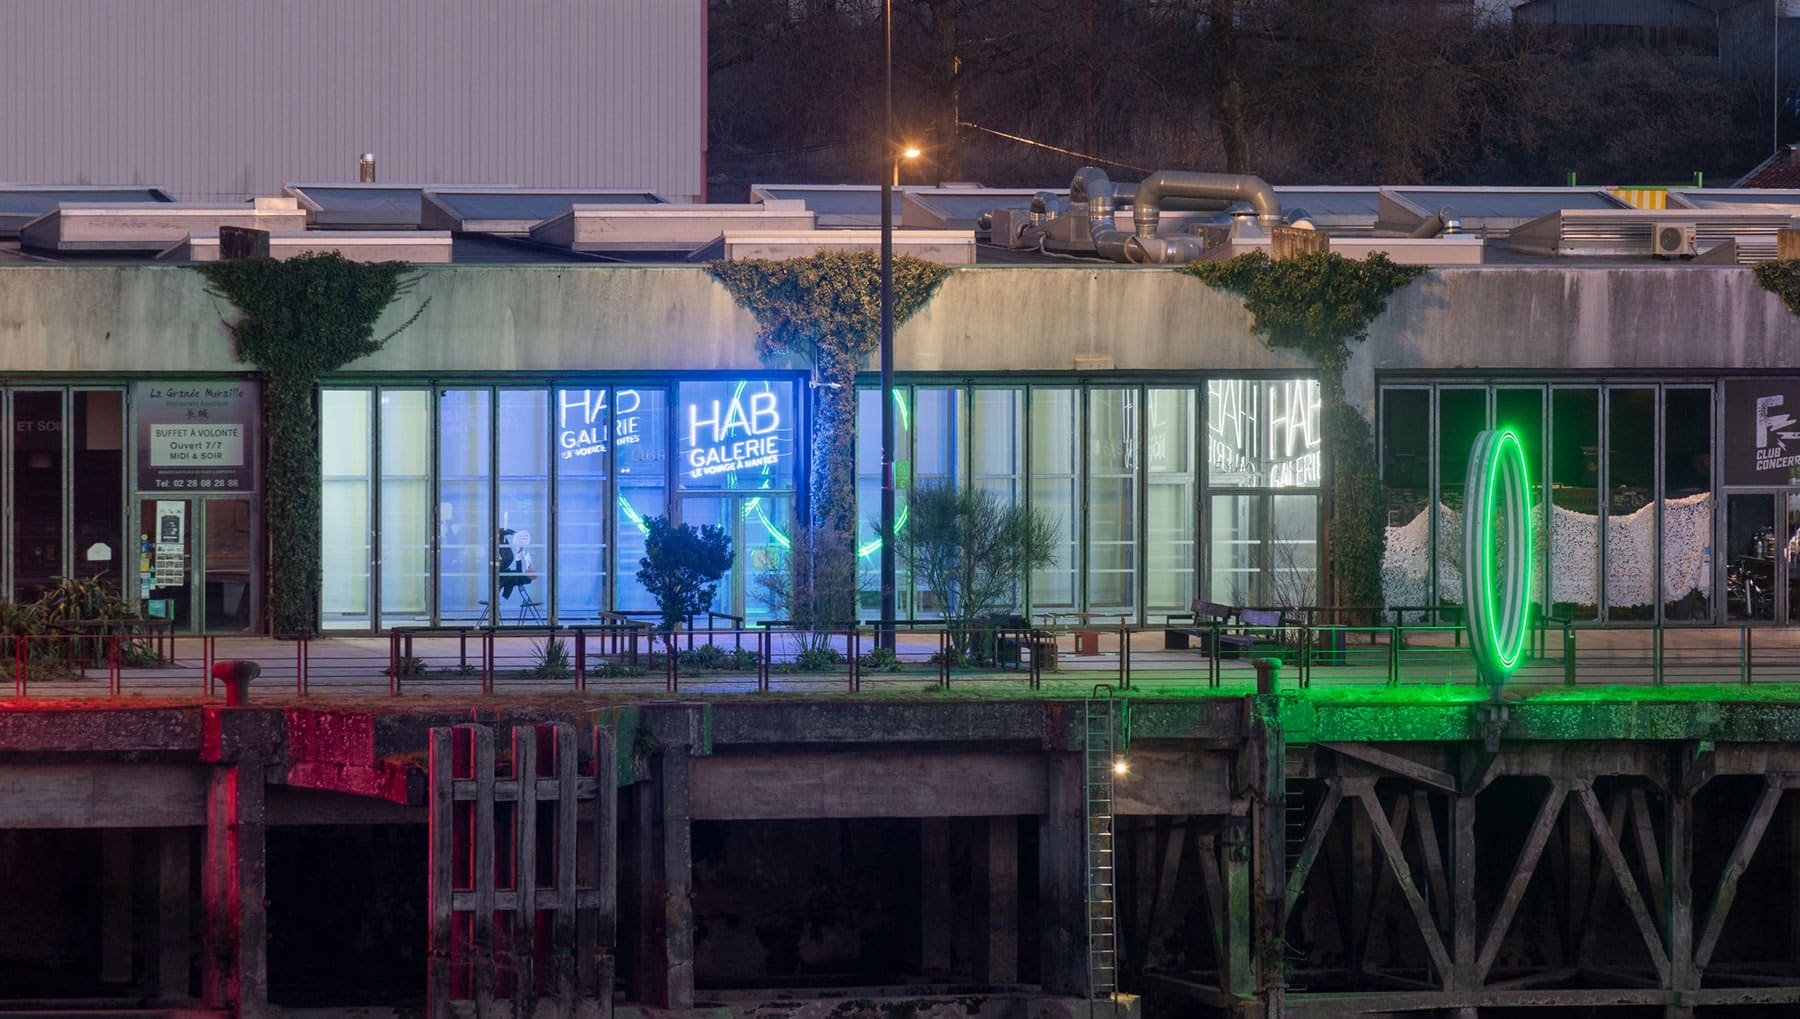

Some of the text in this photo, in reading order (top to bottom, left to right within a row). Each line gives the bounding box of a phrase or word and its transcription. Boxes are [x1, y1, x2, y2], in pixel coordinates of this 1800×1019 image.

[166, 388, 200, 398] Grande
[205, 388, 244, 398] Muraille
[689, 392, 779, 447] HAB
[38, 421, 62, 431] SOI
[156, 428, 238, 437] BUFFET À VOLONTÉ
[170, 441, 223, 450] Ouvert 7/7
[690, 435, 779, 467] GALERIE
[1756, 448, 1781, 460] CLUB
[173, 480, 184, 488] 02
[187, 480, 198, 488] 28
[214, 480, 225, 488] 28
